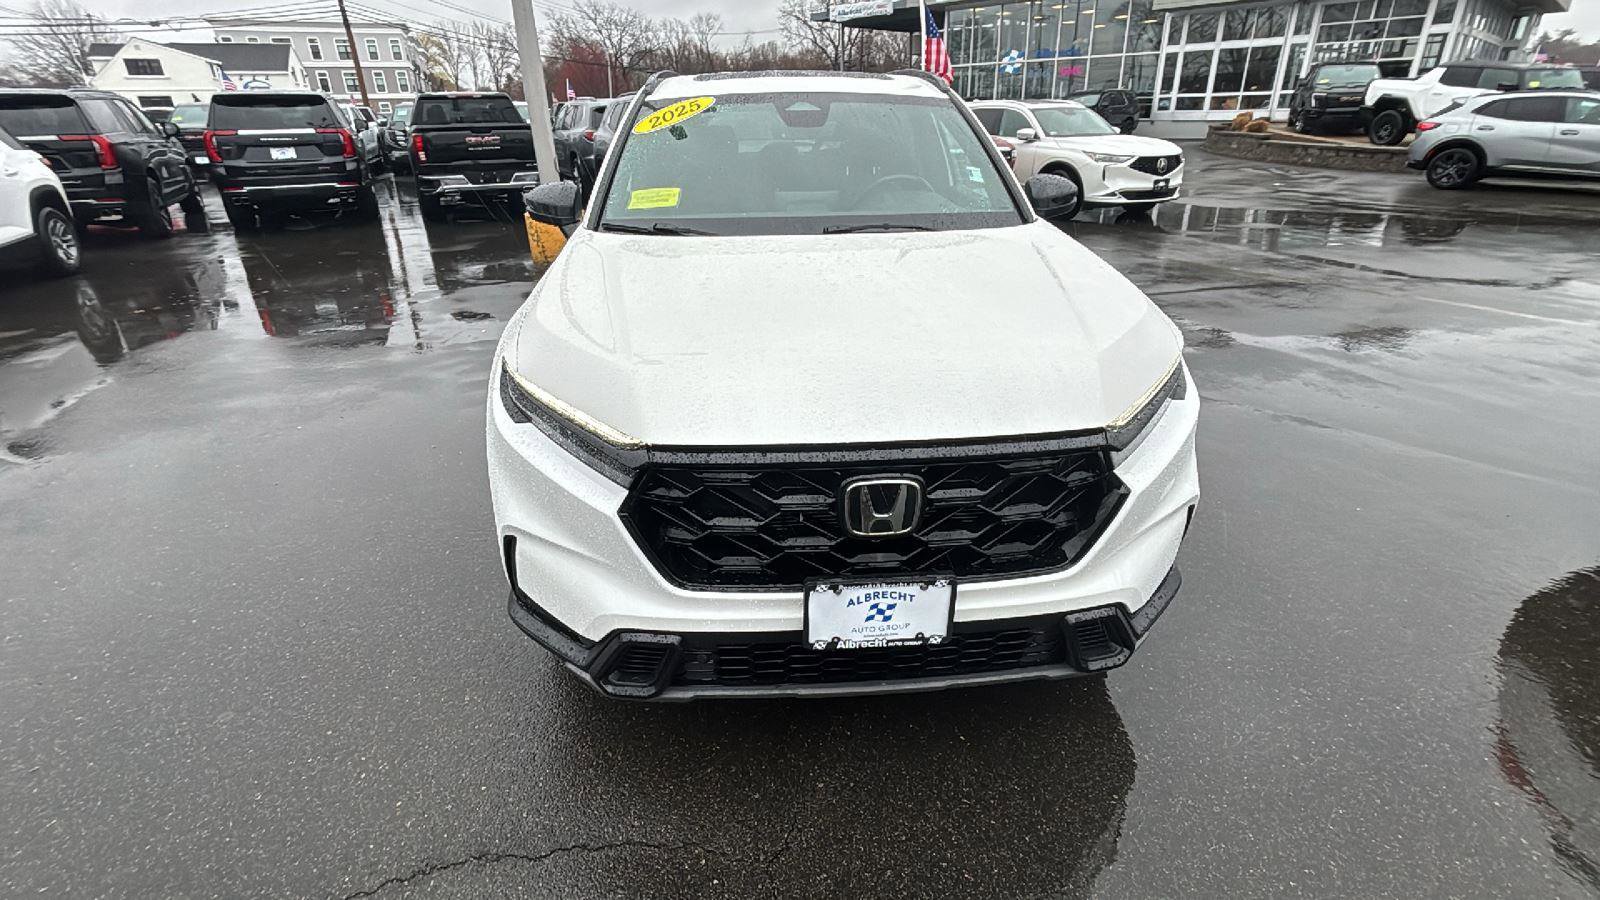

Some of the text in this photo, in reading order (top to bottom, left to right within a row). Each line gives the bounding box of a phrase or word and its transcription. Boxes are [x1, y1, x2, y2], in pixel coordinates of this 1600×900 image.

[649, 100, 701, 128] 2025
[465, 136, 501, 144] GMC
[846, 591, 915, 608] ALBRECHT
[851, 623, 911, 634] AUTO GROUP
[836, 639, 887, 649] Albrecht
